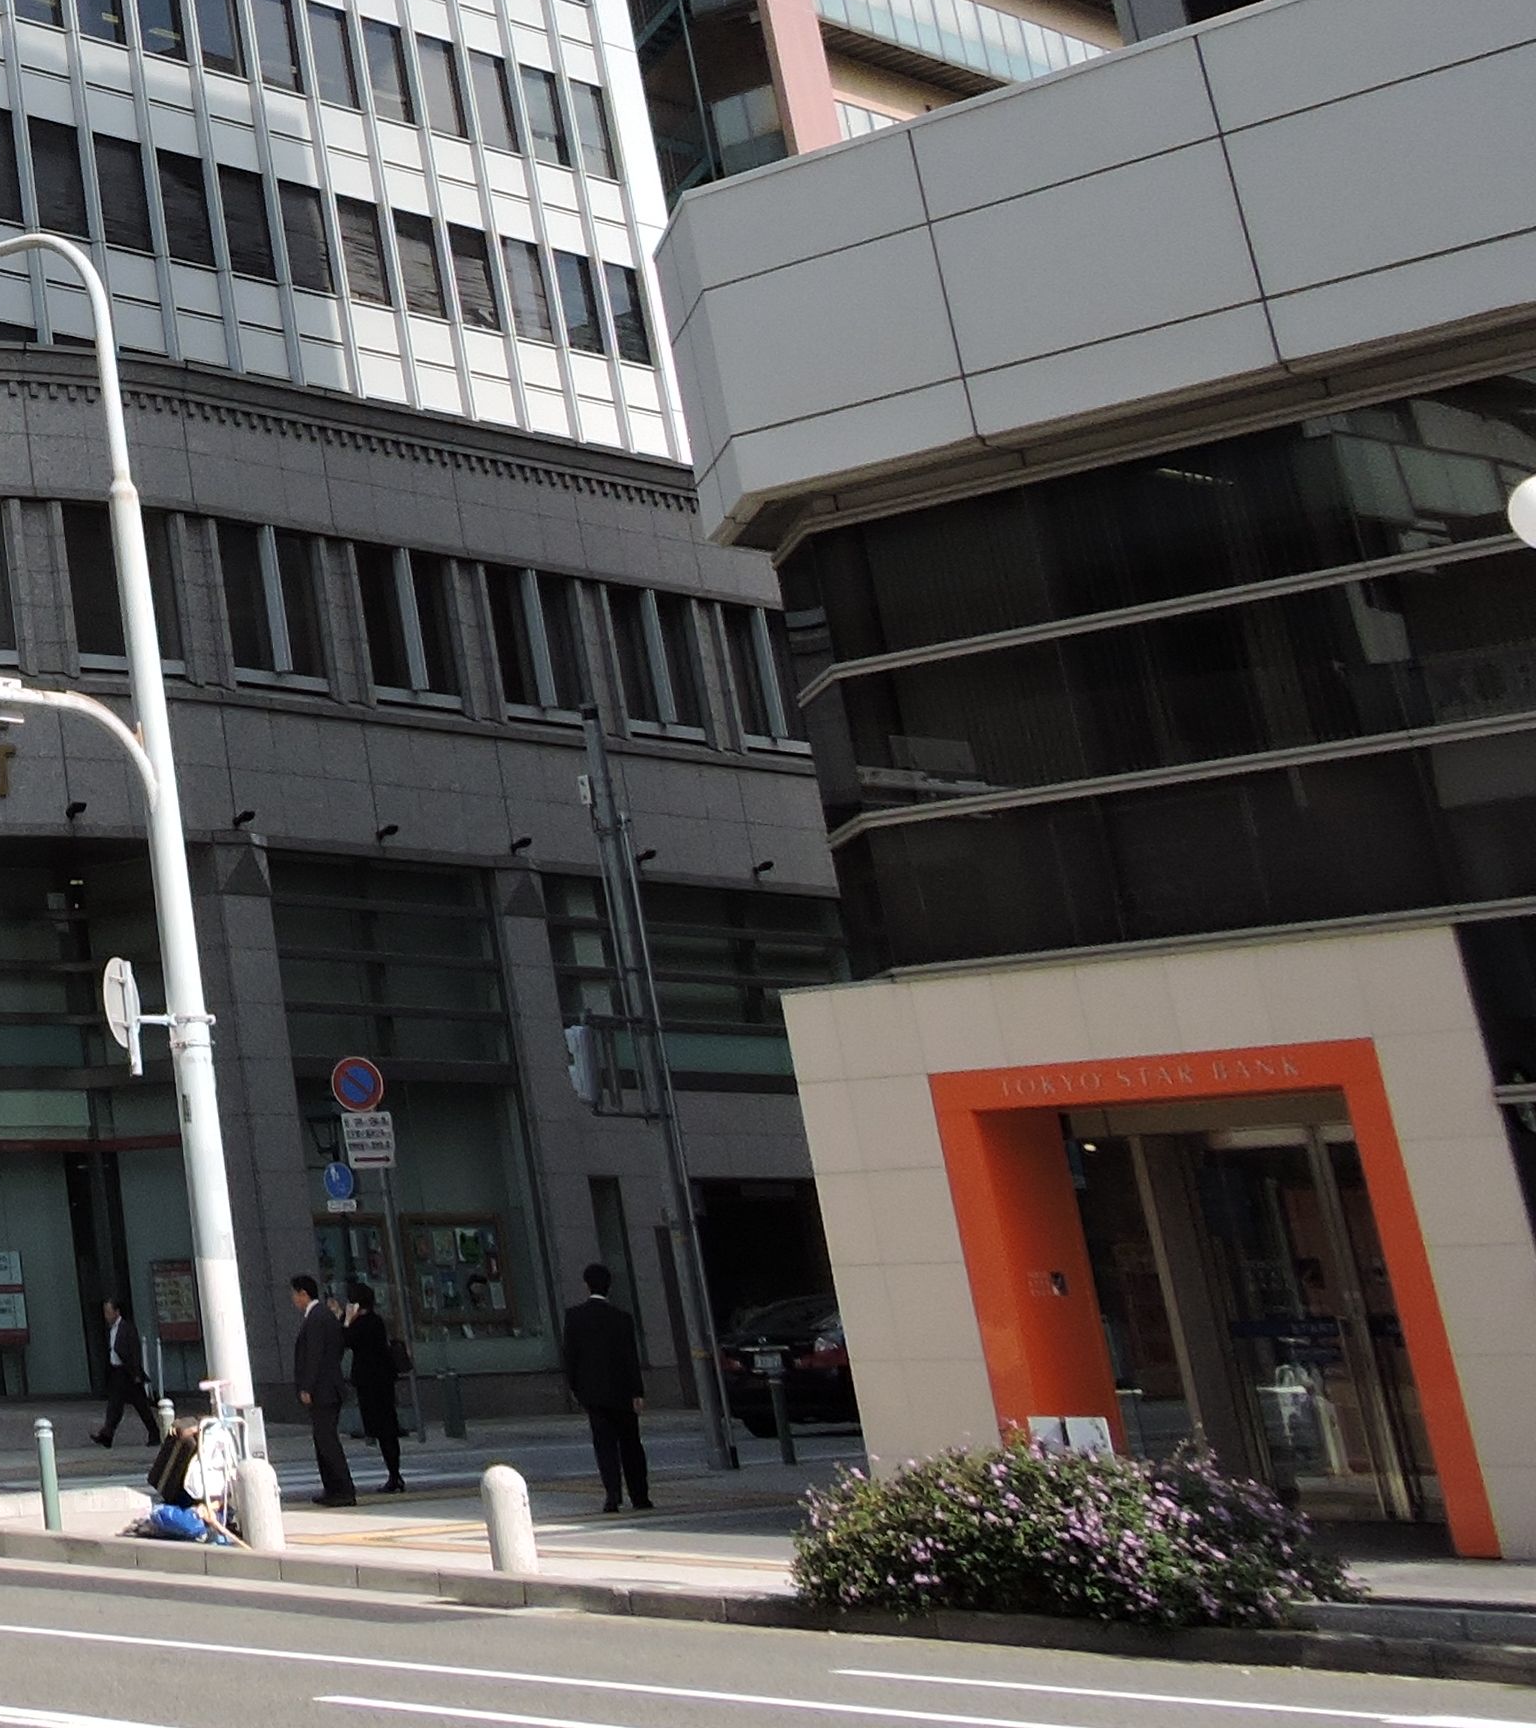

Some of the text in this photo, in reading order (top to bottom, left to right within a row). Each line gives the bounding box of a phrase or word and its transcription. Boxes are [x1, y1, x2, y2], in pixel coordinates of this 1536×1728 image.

[1000, 1056, 1299, 1098] TOKYO STAR BANK
